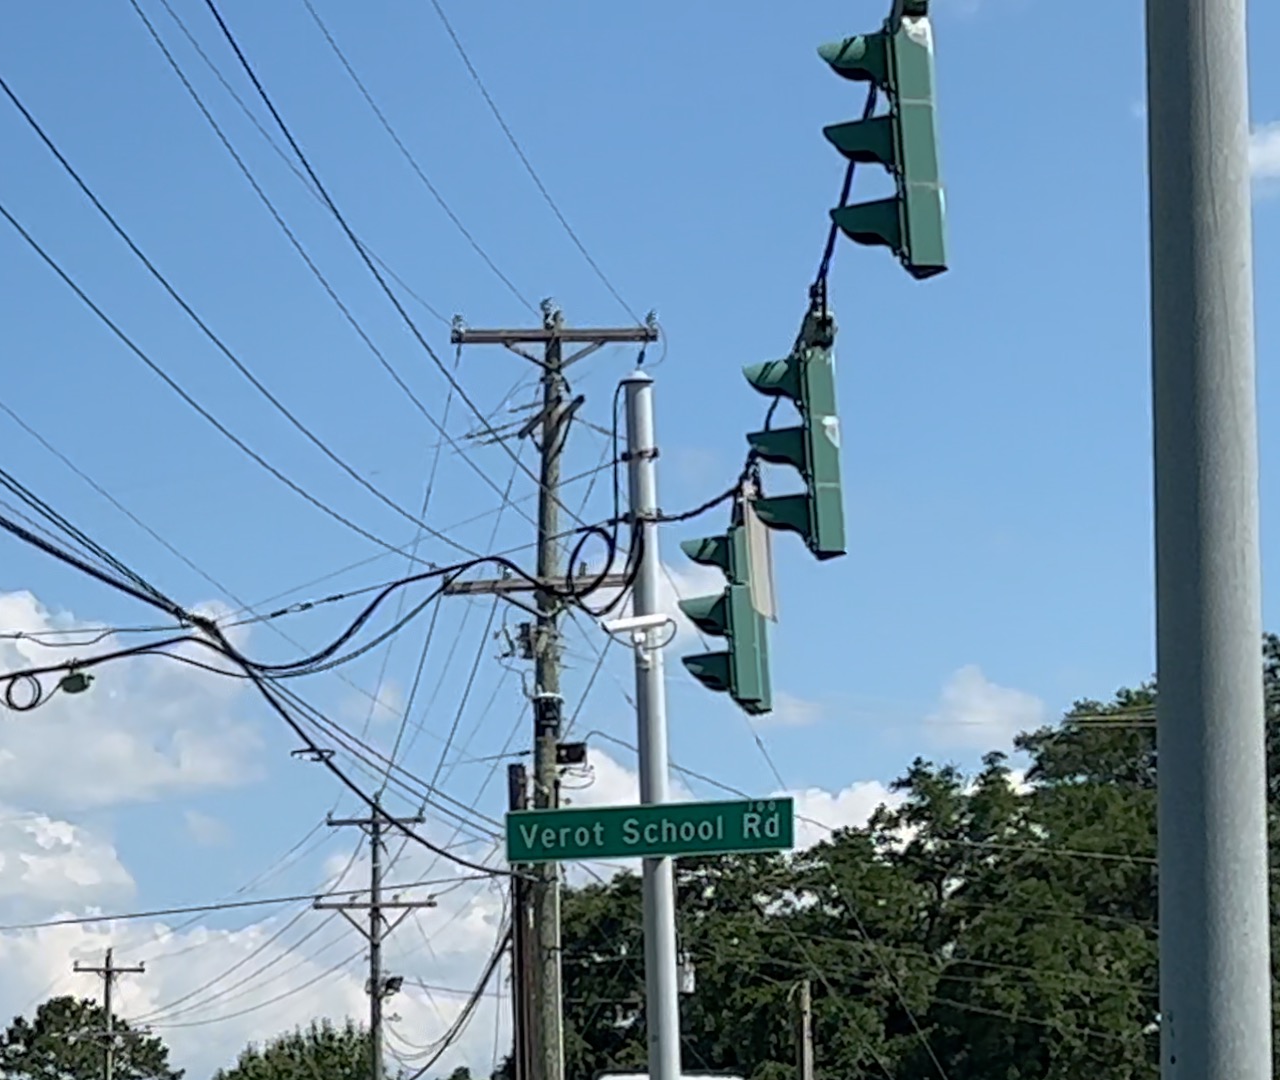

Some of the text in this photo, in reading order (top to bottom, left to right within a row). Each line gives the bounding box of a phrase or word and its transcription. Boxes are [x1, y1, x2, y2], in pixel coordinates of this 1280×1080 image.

[519, 812, 780, 848] Verot School Rd
